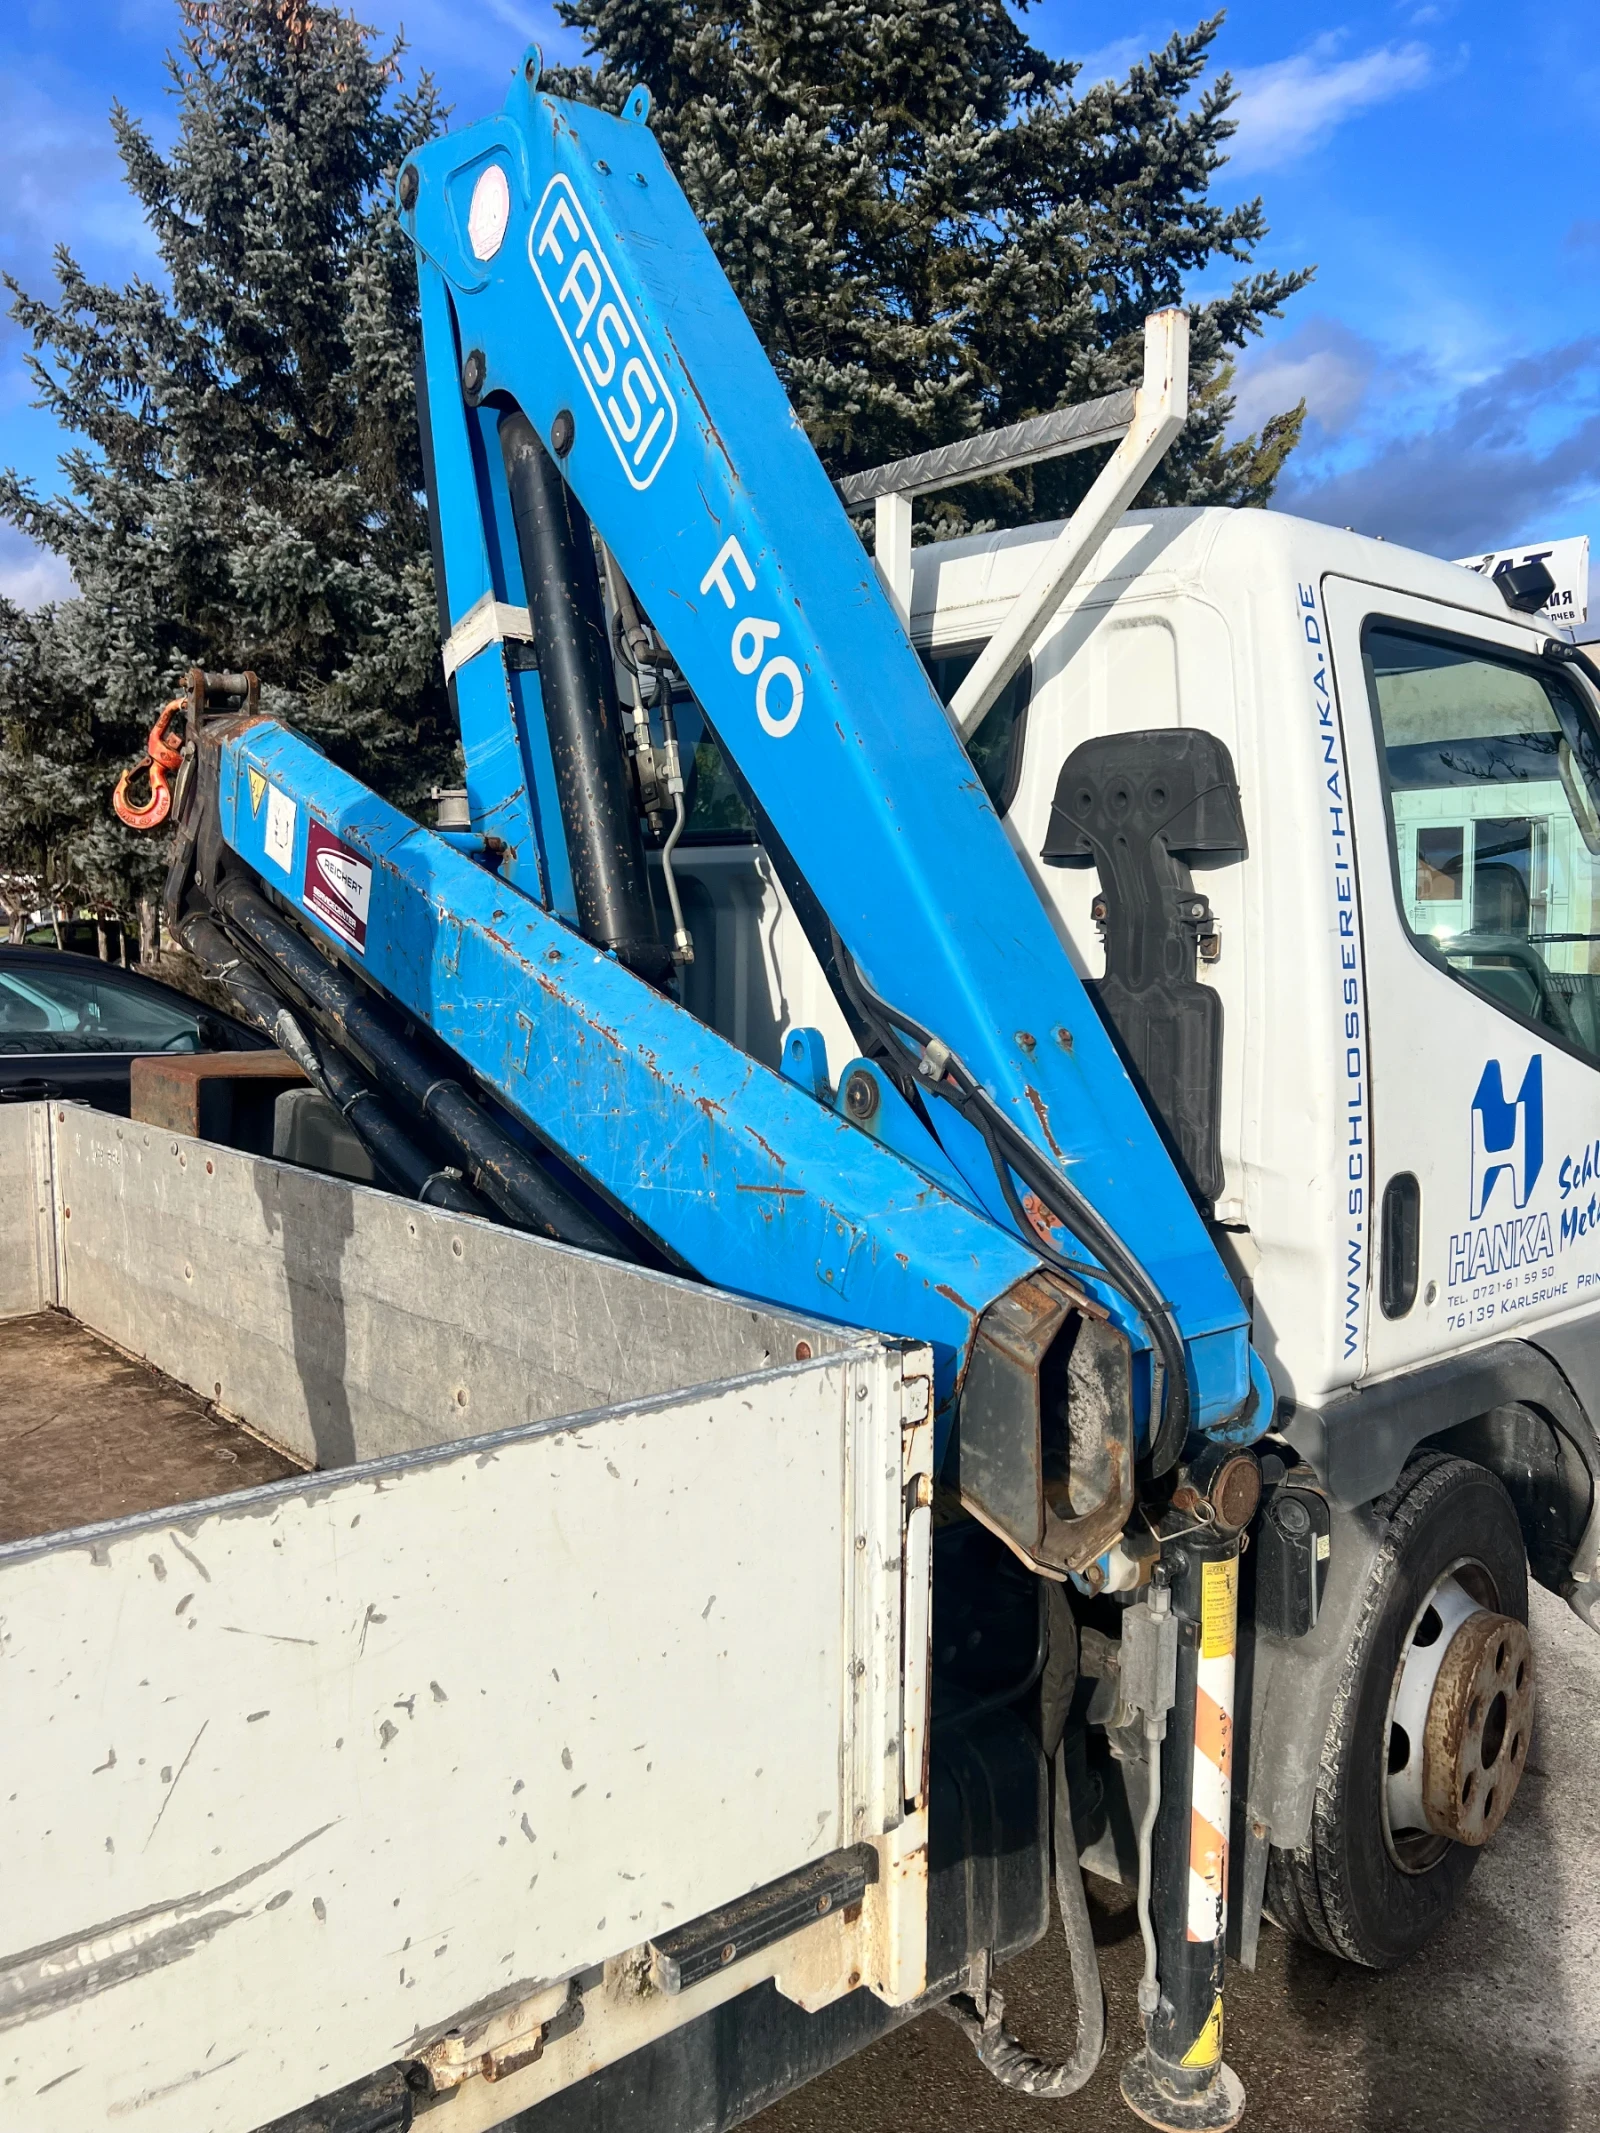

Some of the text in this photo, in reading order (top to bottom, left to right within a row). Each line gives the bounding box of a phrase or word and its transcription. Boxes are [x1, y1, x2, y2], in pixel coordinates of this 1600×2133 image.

[538, 197, 664, 465] FASSI
[700, 534, 804, 738] F 60
[324, 858, 363, 895] REICHERT
[1299, 582, 1364, 1360] WWW.SCHLOSSEREI-HANKA.DE
[1448, 1212, 1554, 1287] HANKA
[1524, 1271, 1537, 1284] 59
[1541, 1266, 1554, 1280] 50
[1447, 1304, 1495, 1332] 76139
[1500, 1282, 1568, 1314] KARLSRUHE
